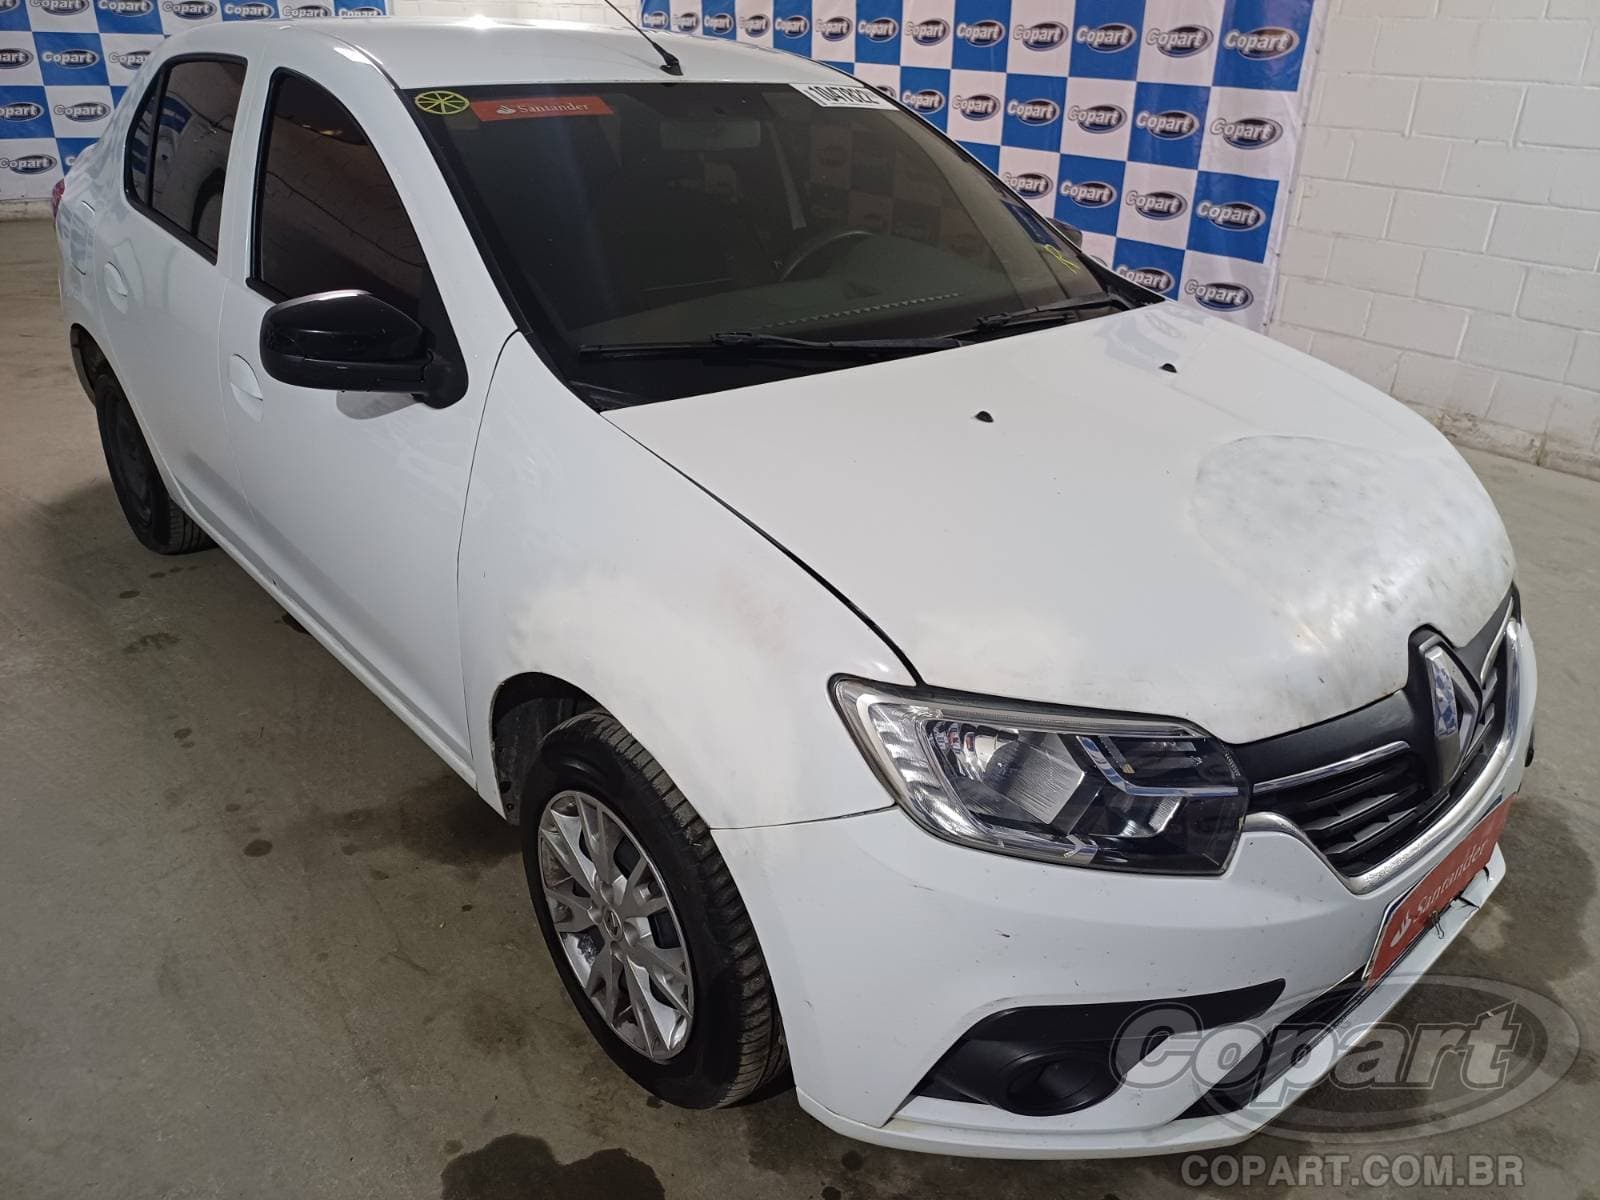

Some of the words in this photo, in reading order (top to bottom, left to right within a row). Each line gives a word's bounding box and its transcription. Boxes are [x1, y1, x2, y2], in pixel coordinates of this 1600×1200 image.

[98, 0, 147, 13] Copart
[163, 1, 210, 13] Copart
[224, 3, 269, 17] Copart
[283, 6, 325, 17] Copart
[858, 20, 894, 40] Copart
[904, 21, 945, 40] Copart
[957, 23, 999, 42] Copart
[1013, 24, 1060, 44] Copart
[1076, 25, 1129, 47] Copart
[1146, 28, 1203, 50] Copart
[1223, 29, 1292, 53] Copart
[42, 51, 94, 65] Copart
[519, 102, 589, 113] Santander
[902, 90, 940, 111] Copart
[952, 95, 994, 115] Copart
[1007, 100, 1053, 121] Copart
[54, 104, 104, 118] Copart
[1068, 105, 1119, 127] Copart
[1136, 111, 1192, 135] Copart
[1210, 117, 1272, 142] Copart
[0, 157, 50, 170] Copart
[1060, 180, 1111, 202] Copart
[1125, 191, 1179, 214] Copart
[1196, 202, 1257, 225] Copart
[1184, 278, 1244, 304] Copart
[1417, 839, 1490, 913] Santander
